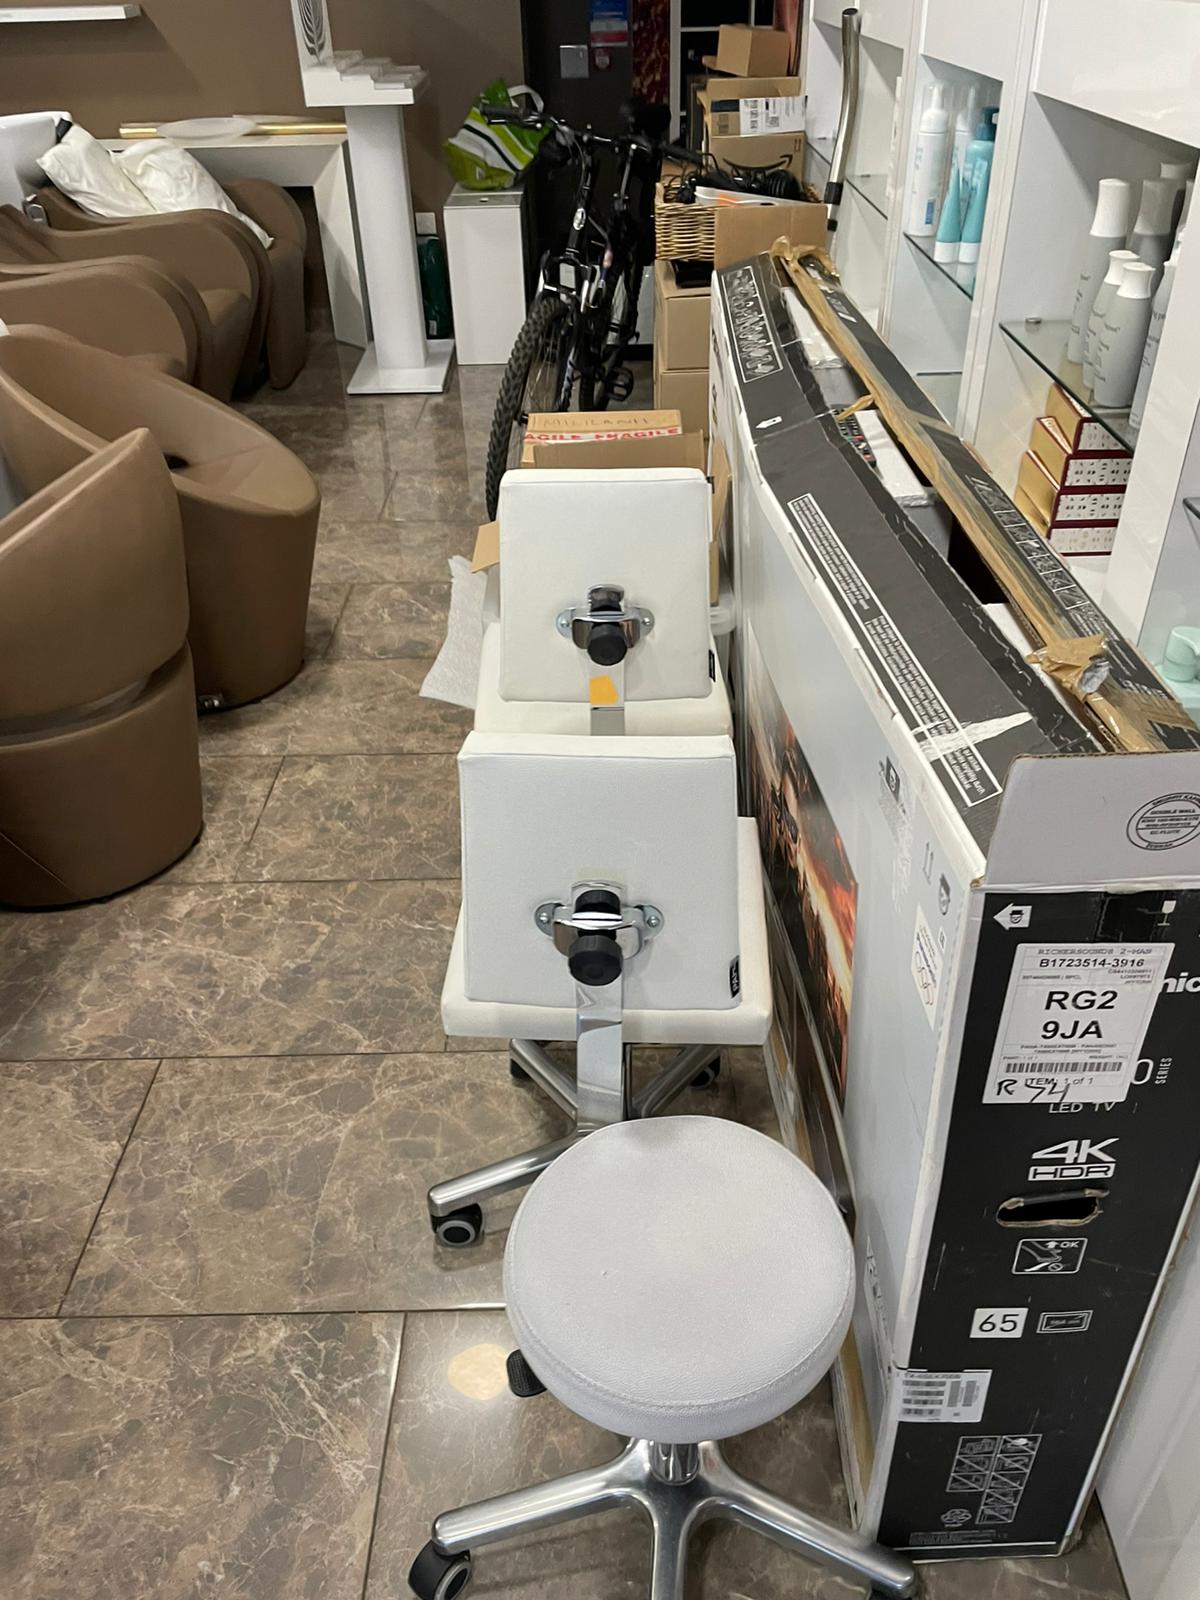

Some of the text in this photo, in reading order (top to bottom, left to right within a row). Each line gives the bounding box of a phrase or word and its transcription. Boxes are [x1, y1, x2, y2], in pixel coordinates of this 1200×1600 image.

[594, 427, 679, 442] FRAGILE
[1039, 958, 1145, 968] B1723514-3916
[1044, 990, 1119, 1011] RG2
[1040, 1020, 1104, 1040] 9JA
[1155, 1056, 1173, 1085] SERIES
[1072, 1077, 1085, 1085] of
[1048, 1101, 1117, 1114] LED TV
[1031, 1137, 1120, 1164] 4K
[1031, 1165, 1112, 1180] HDR
[1060, 1240, 1080, 1249] OK
[978, 1313, 1020, 1333] 65
